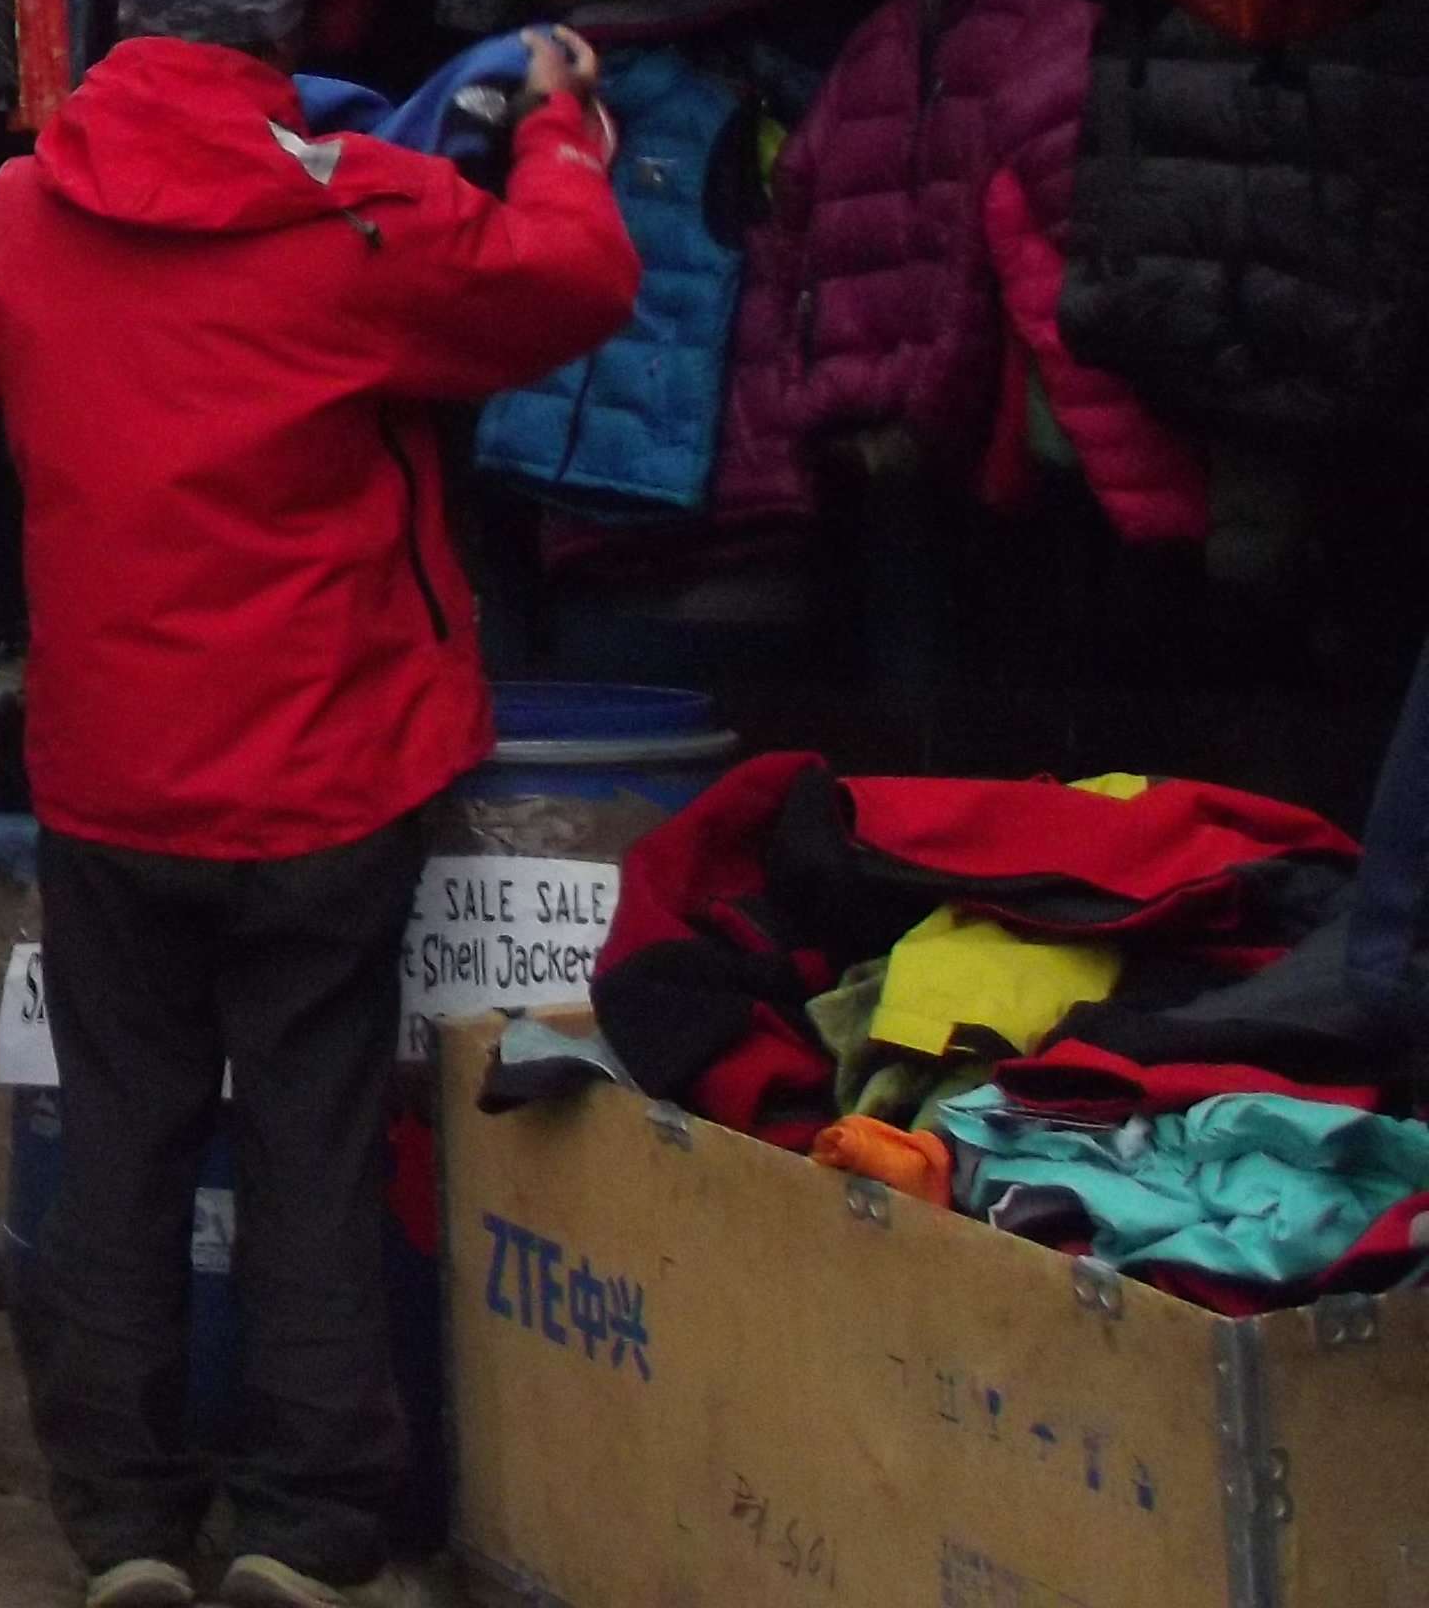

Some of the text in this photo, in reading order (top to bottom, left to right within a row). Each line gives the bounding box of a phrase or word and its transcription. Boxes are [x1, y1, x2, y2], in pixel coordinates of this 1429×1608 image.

[443, 877, 607, 925] SALE SALE
[421, 932, 488, 993] Shell
